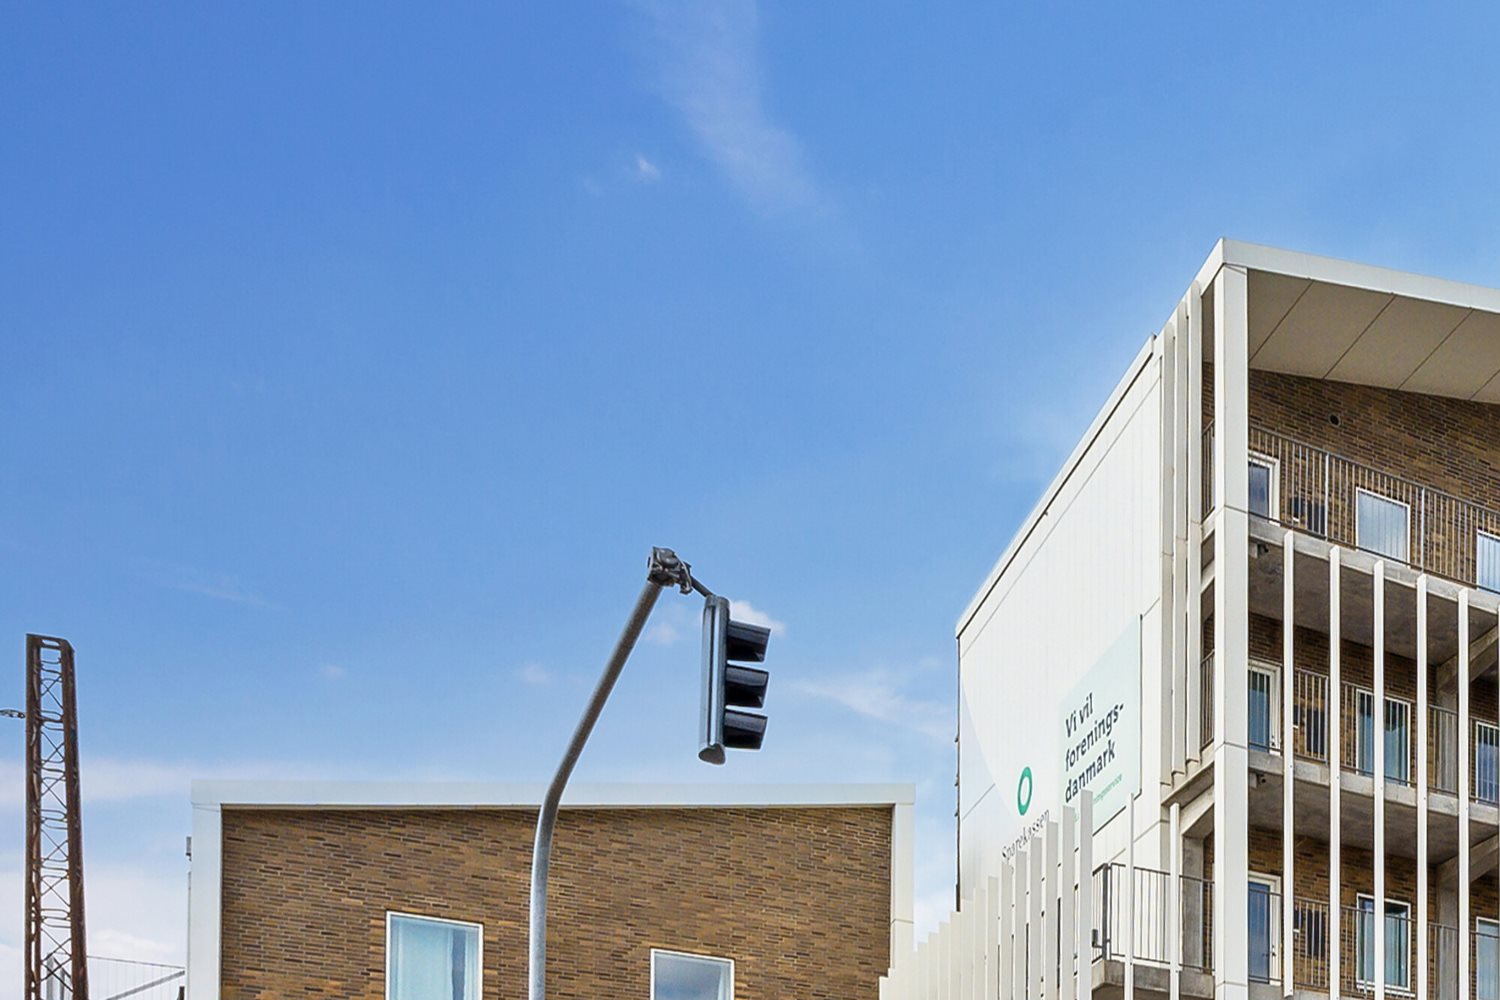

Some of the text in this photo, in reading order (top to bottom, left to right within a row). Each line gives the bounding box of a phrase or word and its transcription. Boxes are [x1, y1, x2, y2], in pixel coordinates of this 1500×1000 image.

[1065, 692, 1093, 738] Vi vil
[1065, 703, 1124, 772] forenings-
[1065, 739, 1115, 803] danmark
